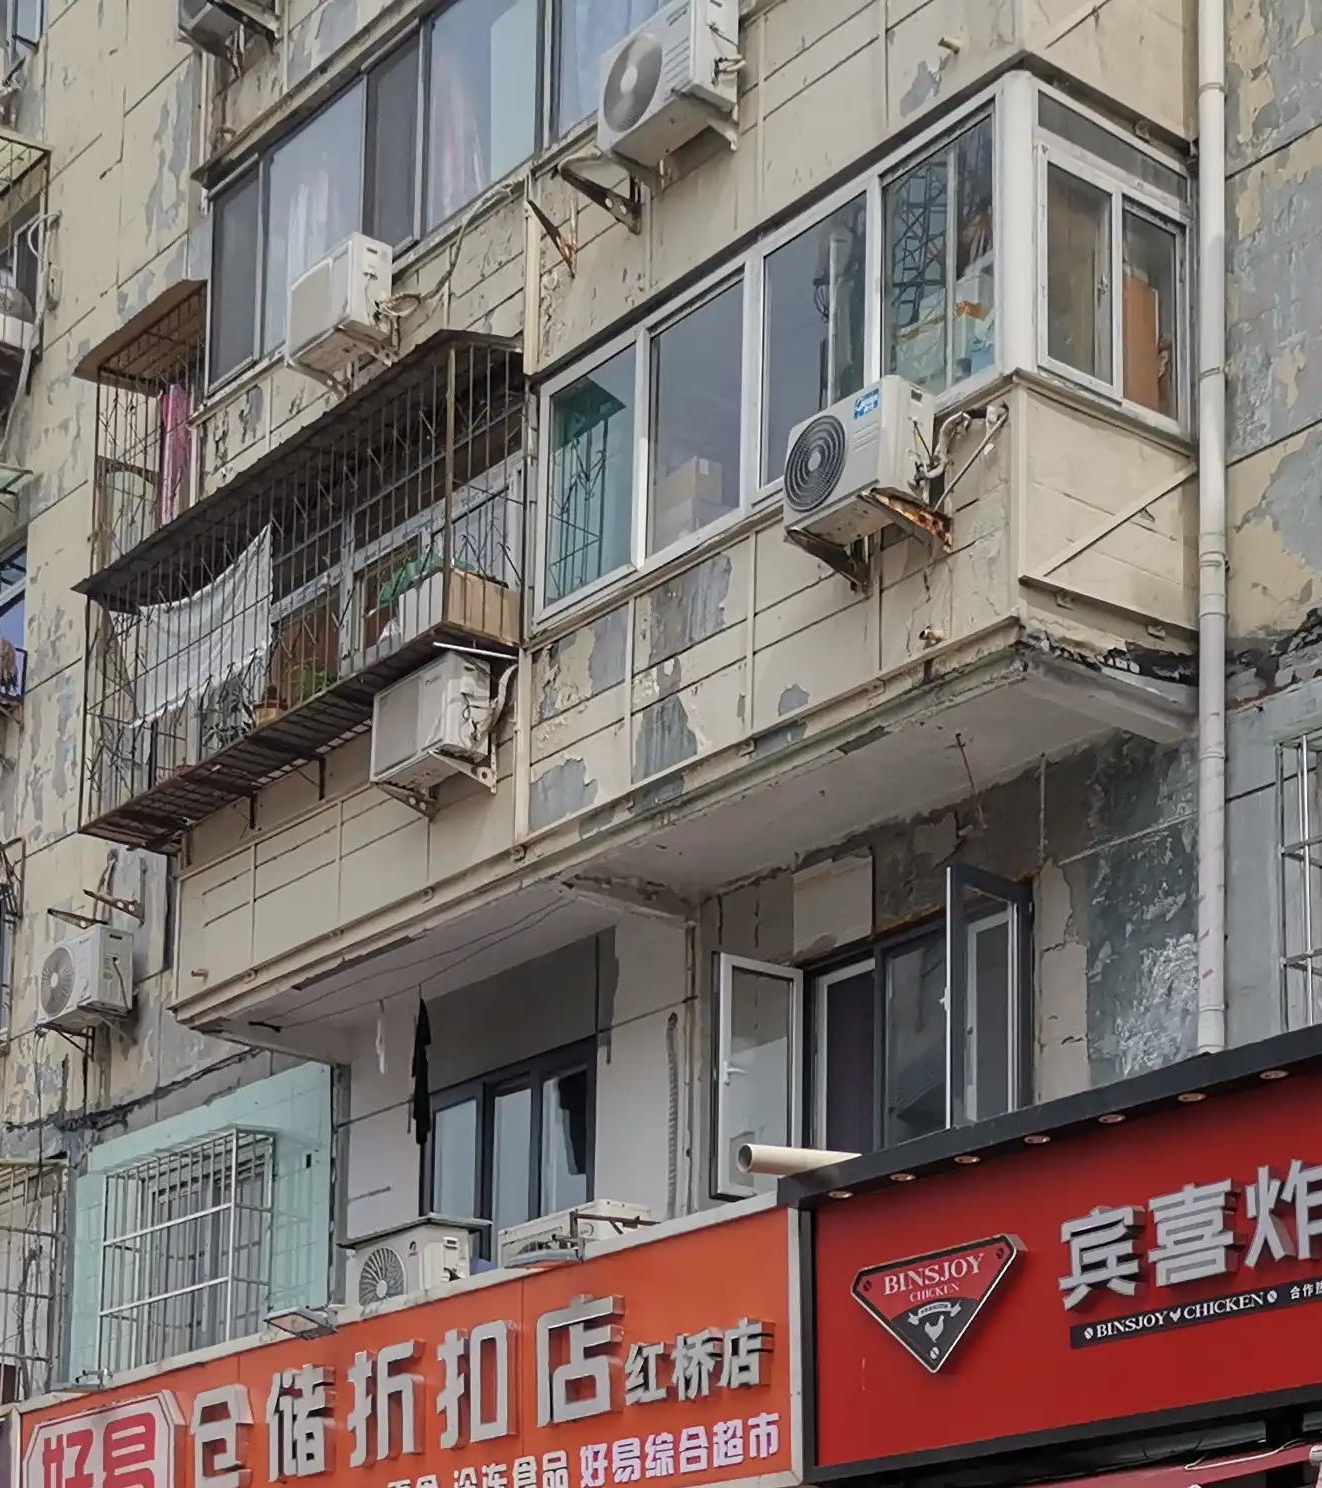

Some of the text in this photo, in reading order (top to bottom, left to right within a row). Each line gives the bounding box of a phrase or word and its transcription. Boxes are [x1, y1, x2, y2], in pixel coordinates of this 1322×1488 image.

[884, 1253, 985, 1296] BINSJOY
[909, 1281, 960, 1303] CHICKEN
[1096, 1292, 1266, 1339] BINSJOY CHICKEN
[624, 1316, 776, 1406] 红桥店
